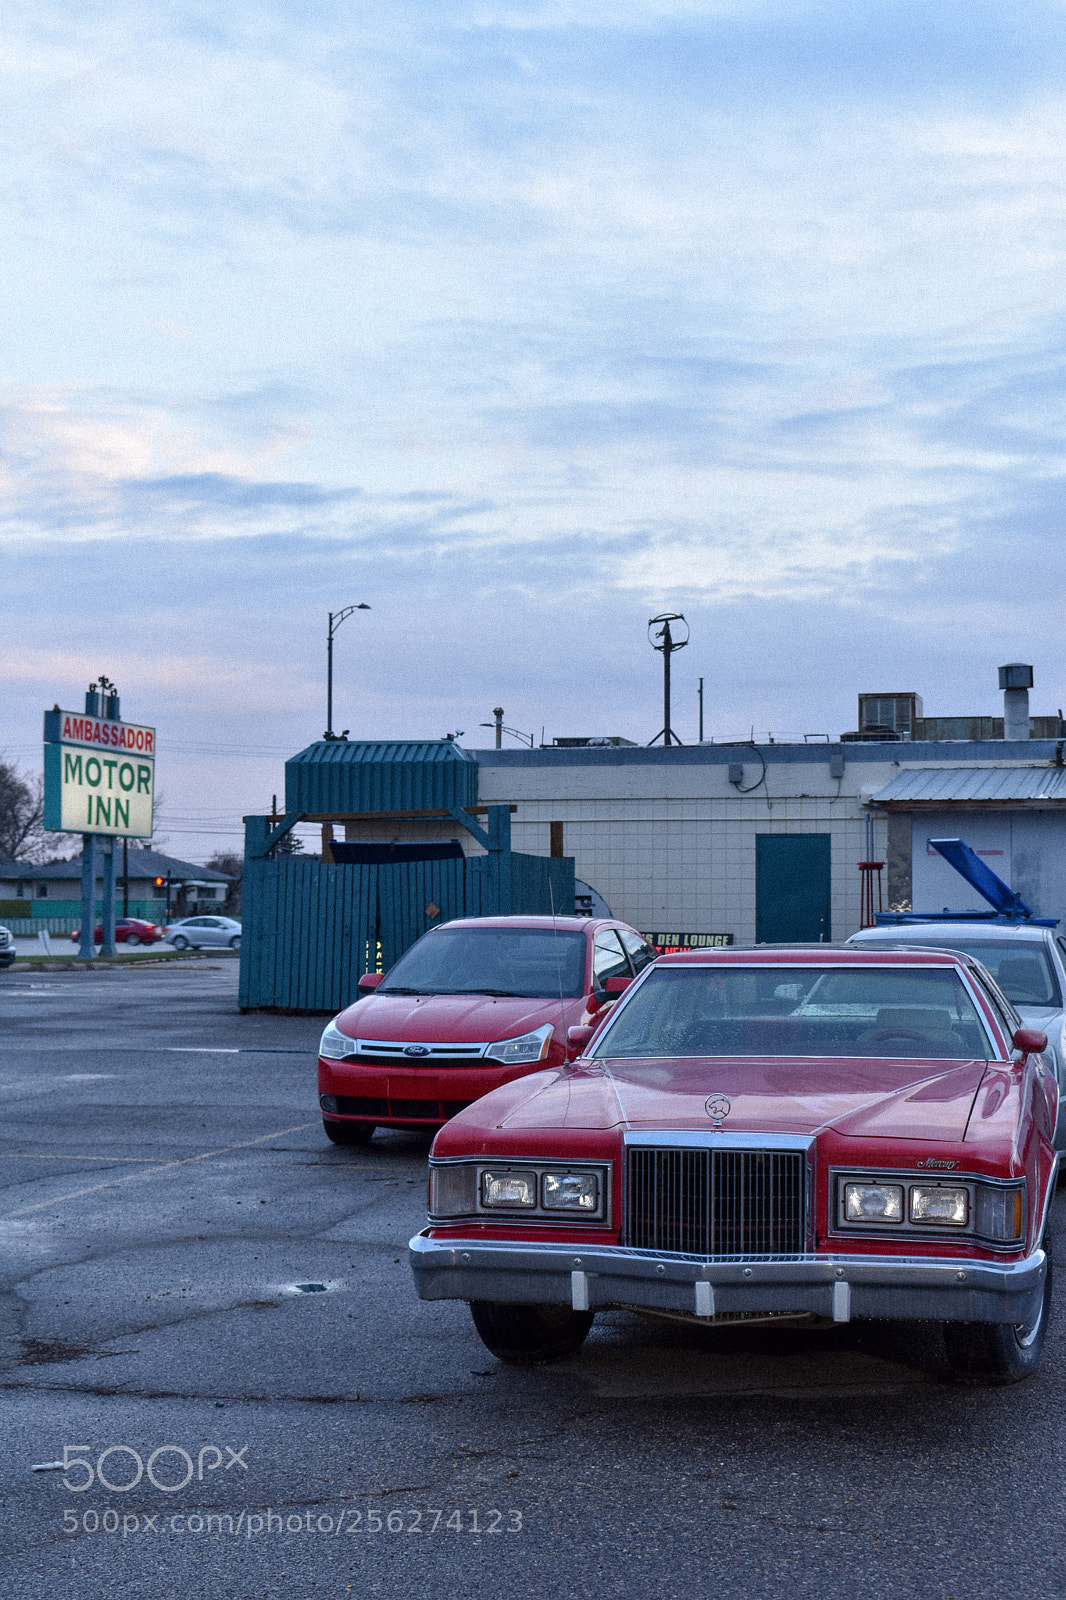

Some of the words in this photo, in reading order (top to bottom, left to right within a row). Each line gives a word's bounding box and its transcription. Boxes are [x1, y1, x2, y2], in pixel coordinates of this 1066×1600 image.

[62, 717, 153, 751] AMBASSADOR
[65, 753, 151, 794] MOTOR
[87, 795, 130, 828] INN
[658, 934, 680, 946] DEN
[684, 935, 729, 946] LOUNGE
[917, 1157, 960, 1169] Mercury
